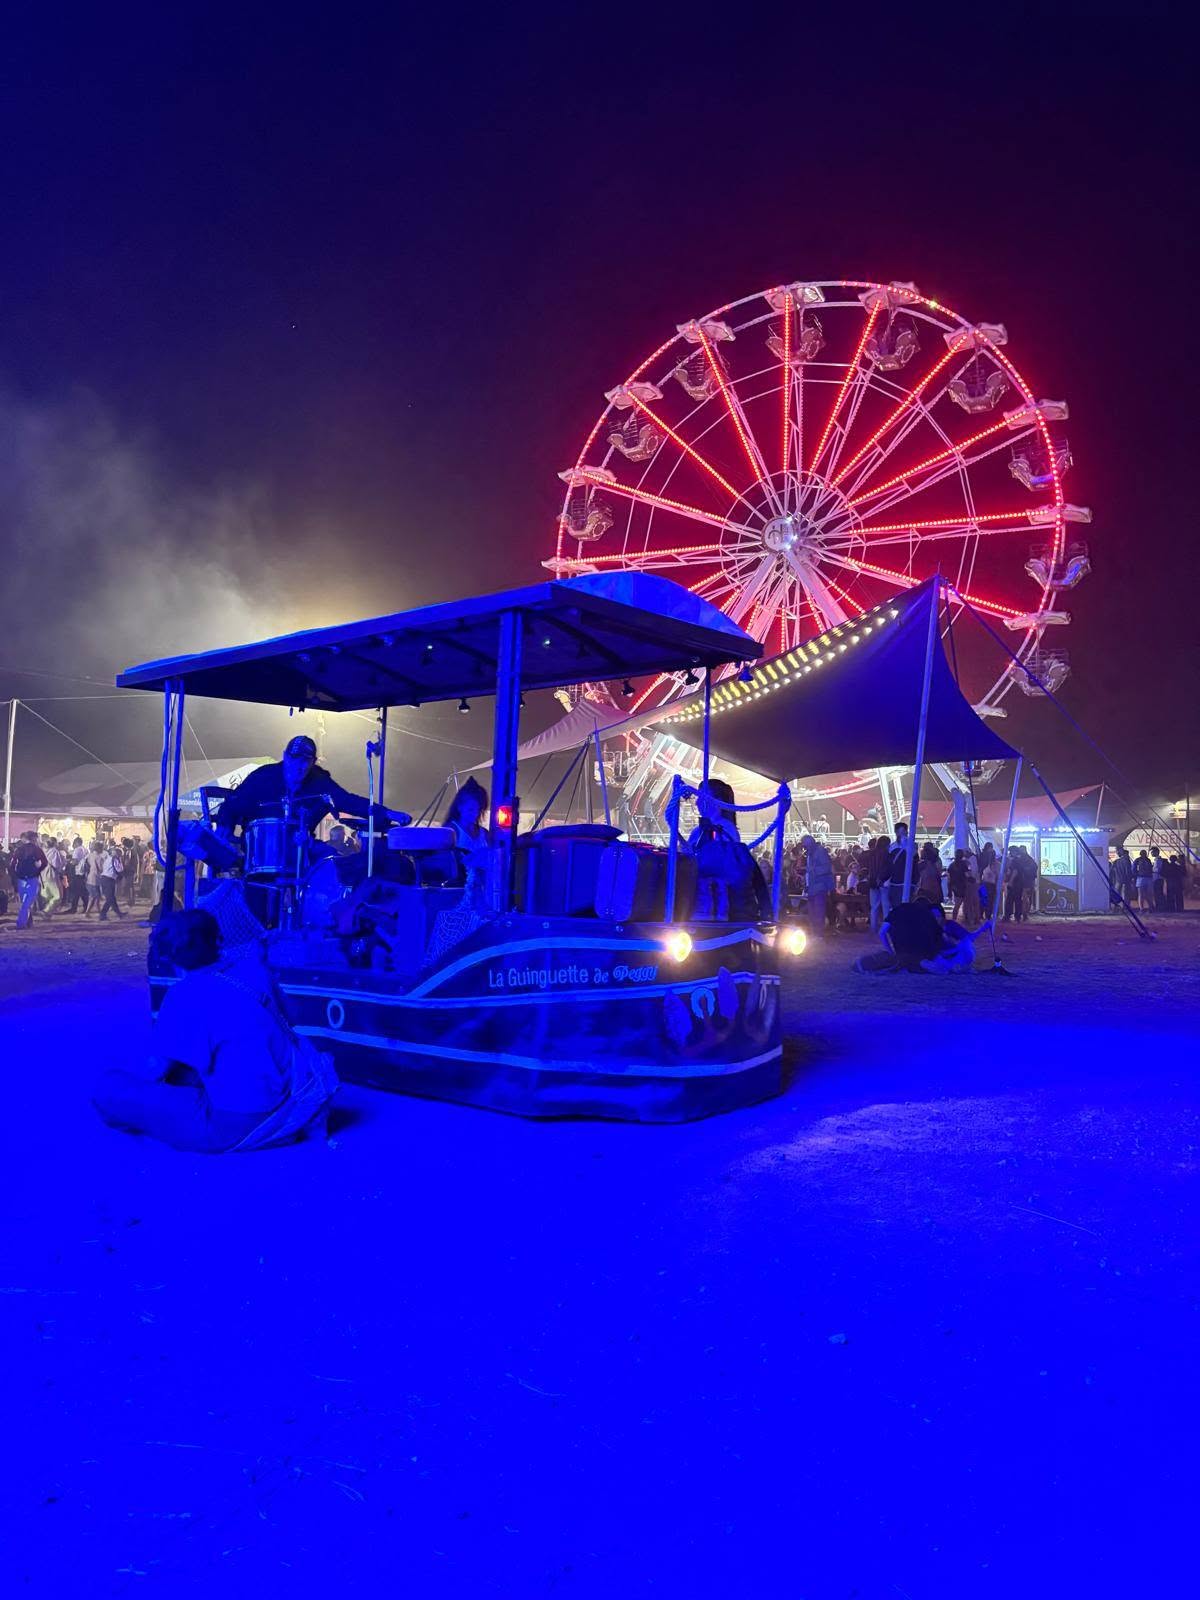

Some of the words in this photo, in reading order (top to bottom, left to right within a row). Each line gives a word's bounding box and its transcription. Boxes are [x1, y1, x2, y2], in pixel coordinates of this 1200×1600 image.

[489, 969, 504, 987] La
[508, 965, 588, 989] Guinguette
[593, 968, 609, 984] de
[613, 965, 658, 982] Peggy
